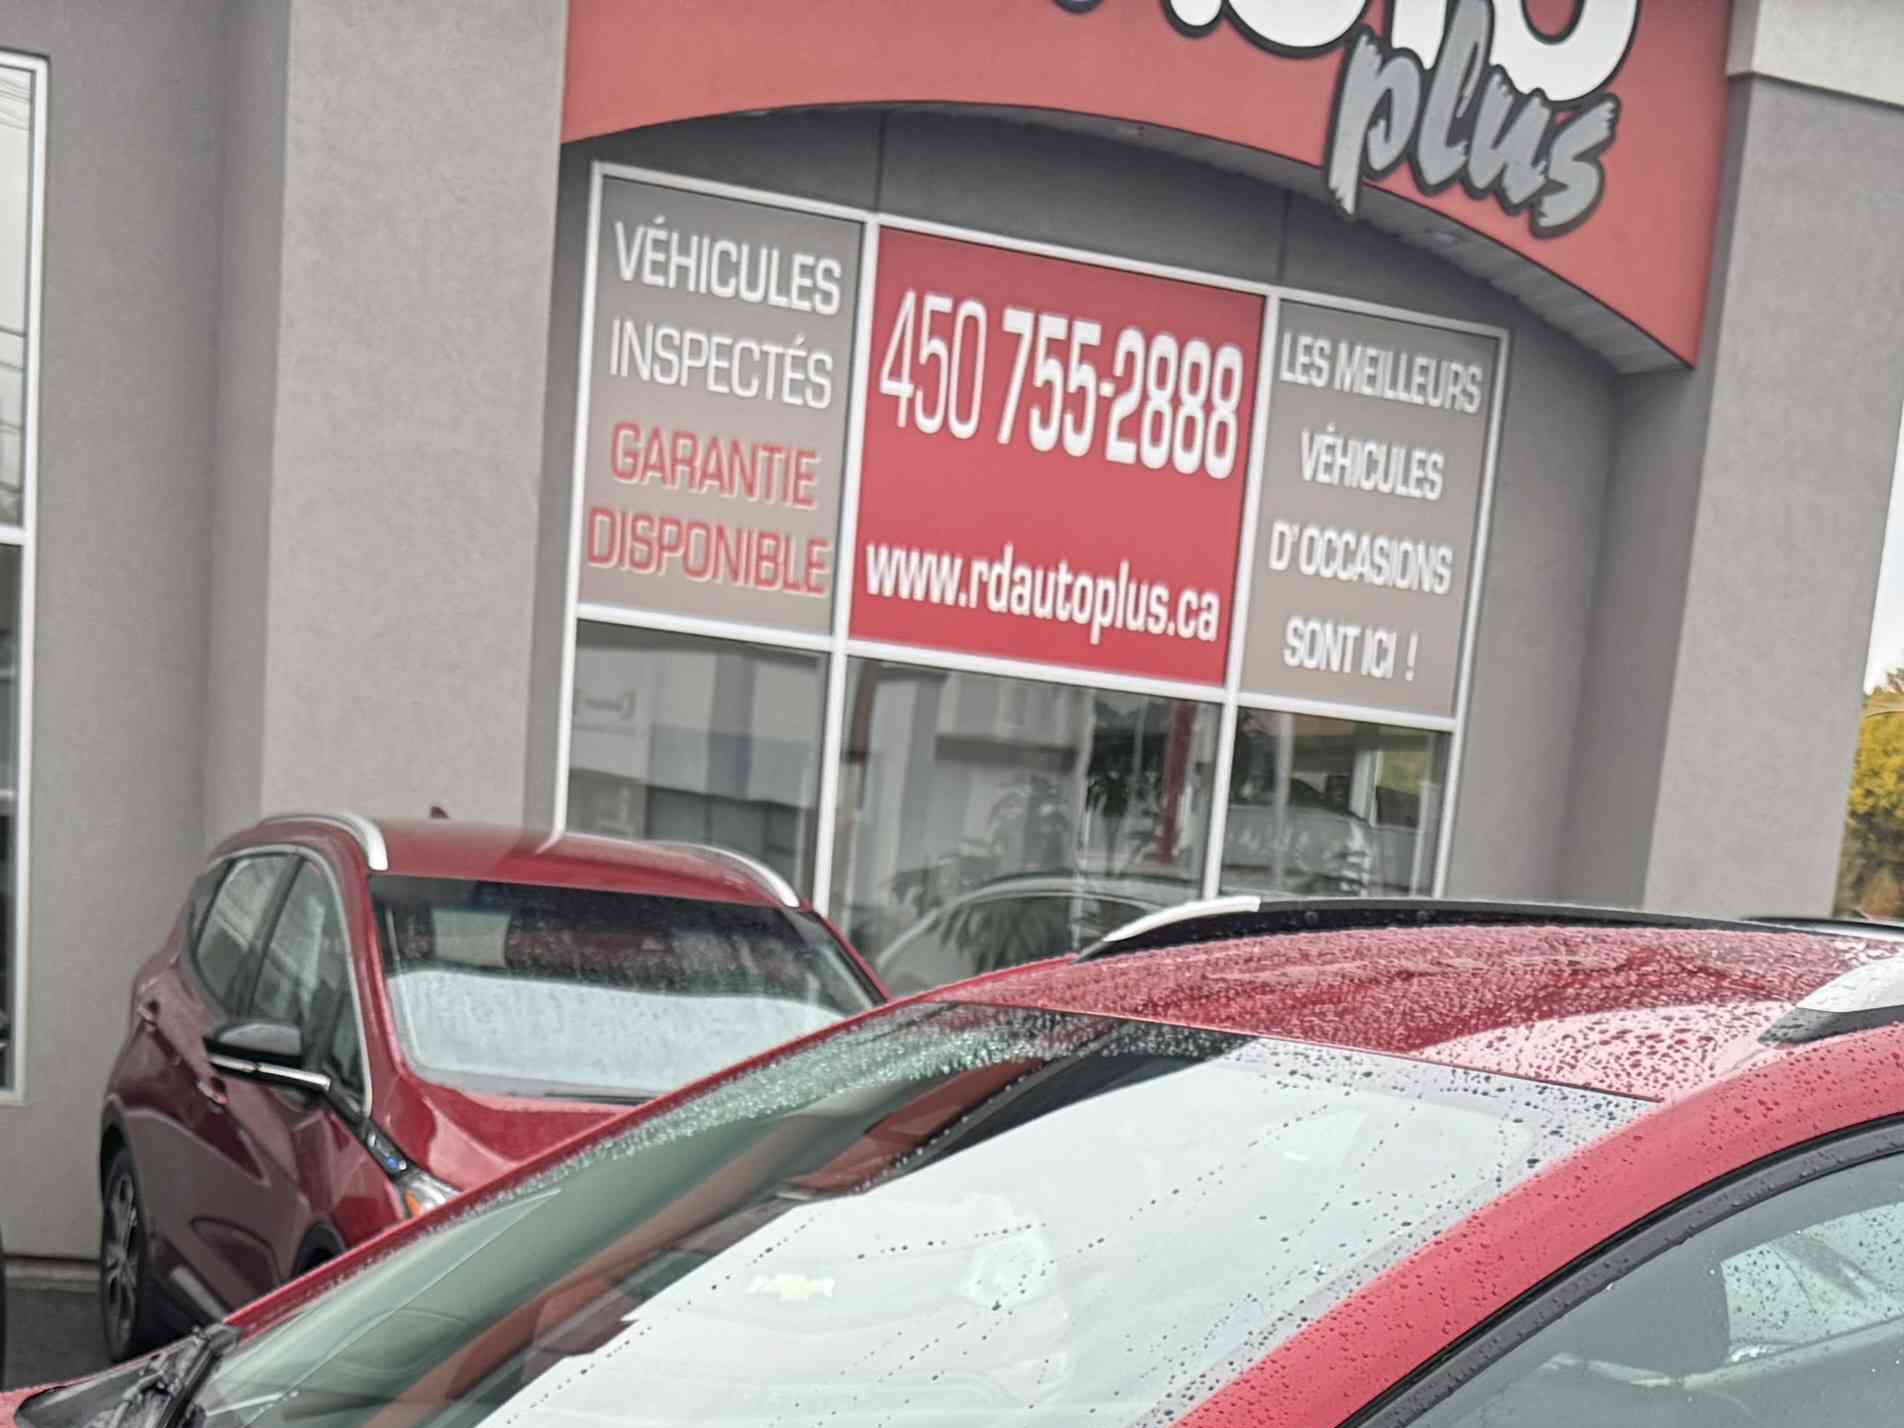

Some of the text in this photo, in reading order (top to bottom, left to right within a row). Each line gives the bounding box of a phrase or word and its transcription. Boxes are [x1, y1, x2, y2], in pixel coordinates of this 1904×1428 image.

[1326, 0, 1618, 230] plus
[613, 214, 842, 315] VÉHICULES
[609, 318, 833, 410] INSPECTÉS
[879, 289, 1245, 480] 450 755-2888
[1279, 331, 1483, 414] LES MEILLEURS
[611, 419, 821, 510] GARANTIE
[1301, 421, 1445, 501] VÉHICULES
[587, 506, 832, 599] DISPONIBLE
[865, 540, 1220, 646] www.rdautoplus.ca
[1283, 616, 1361, 674] SONT
[1361, 625, 1397, 680] ICI
